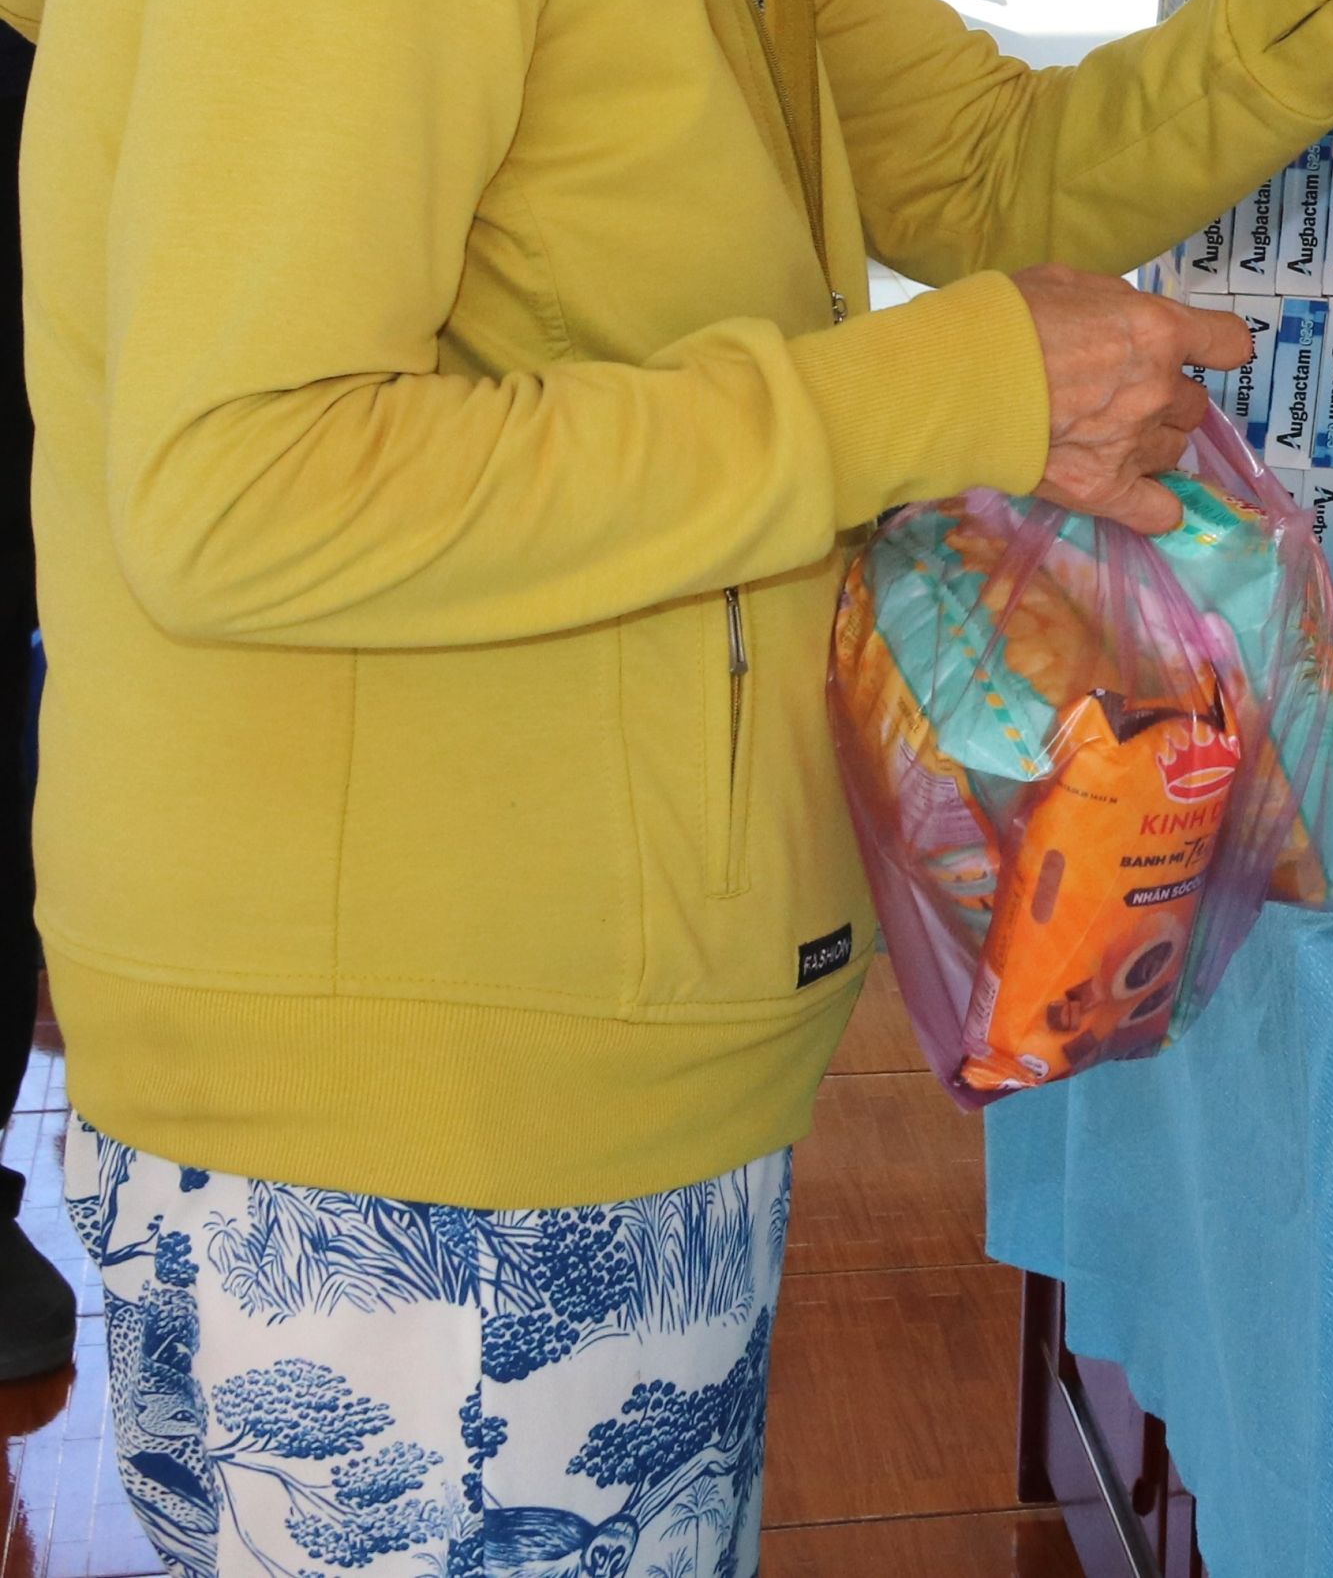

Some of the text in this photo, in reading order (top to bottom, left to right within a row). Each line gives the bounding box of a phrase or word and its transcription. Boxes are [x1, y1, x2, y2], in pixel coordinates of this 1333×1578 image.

[1287, 144, 1321, 277] Augbactam 625
[1276, 319, 1314, 450] Augbactam 625
[1140, 809, 1204, 836] KINH
[803, 936, 851, 975] FASHION
